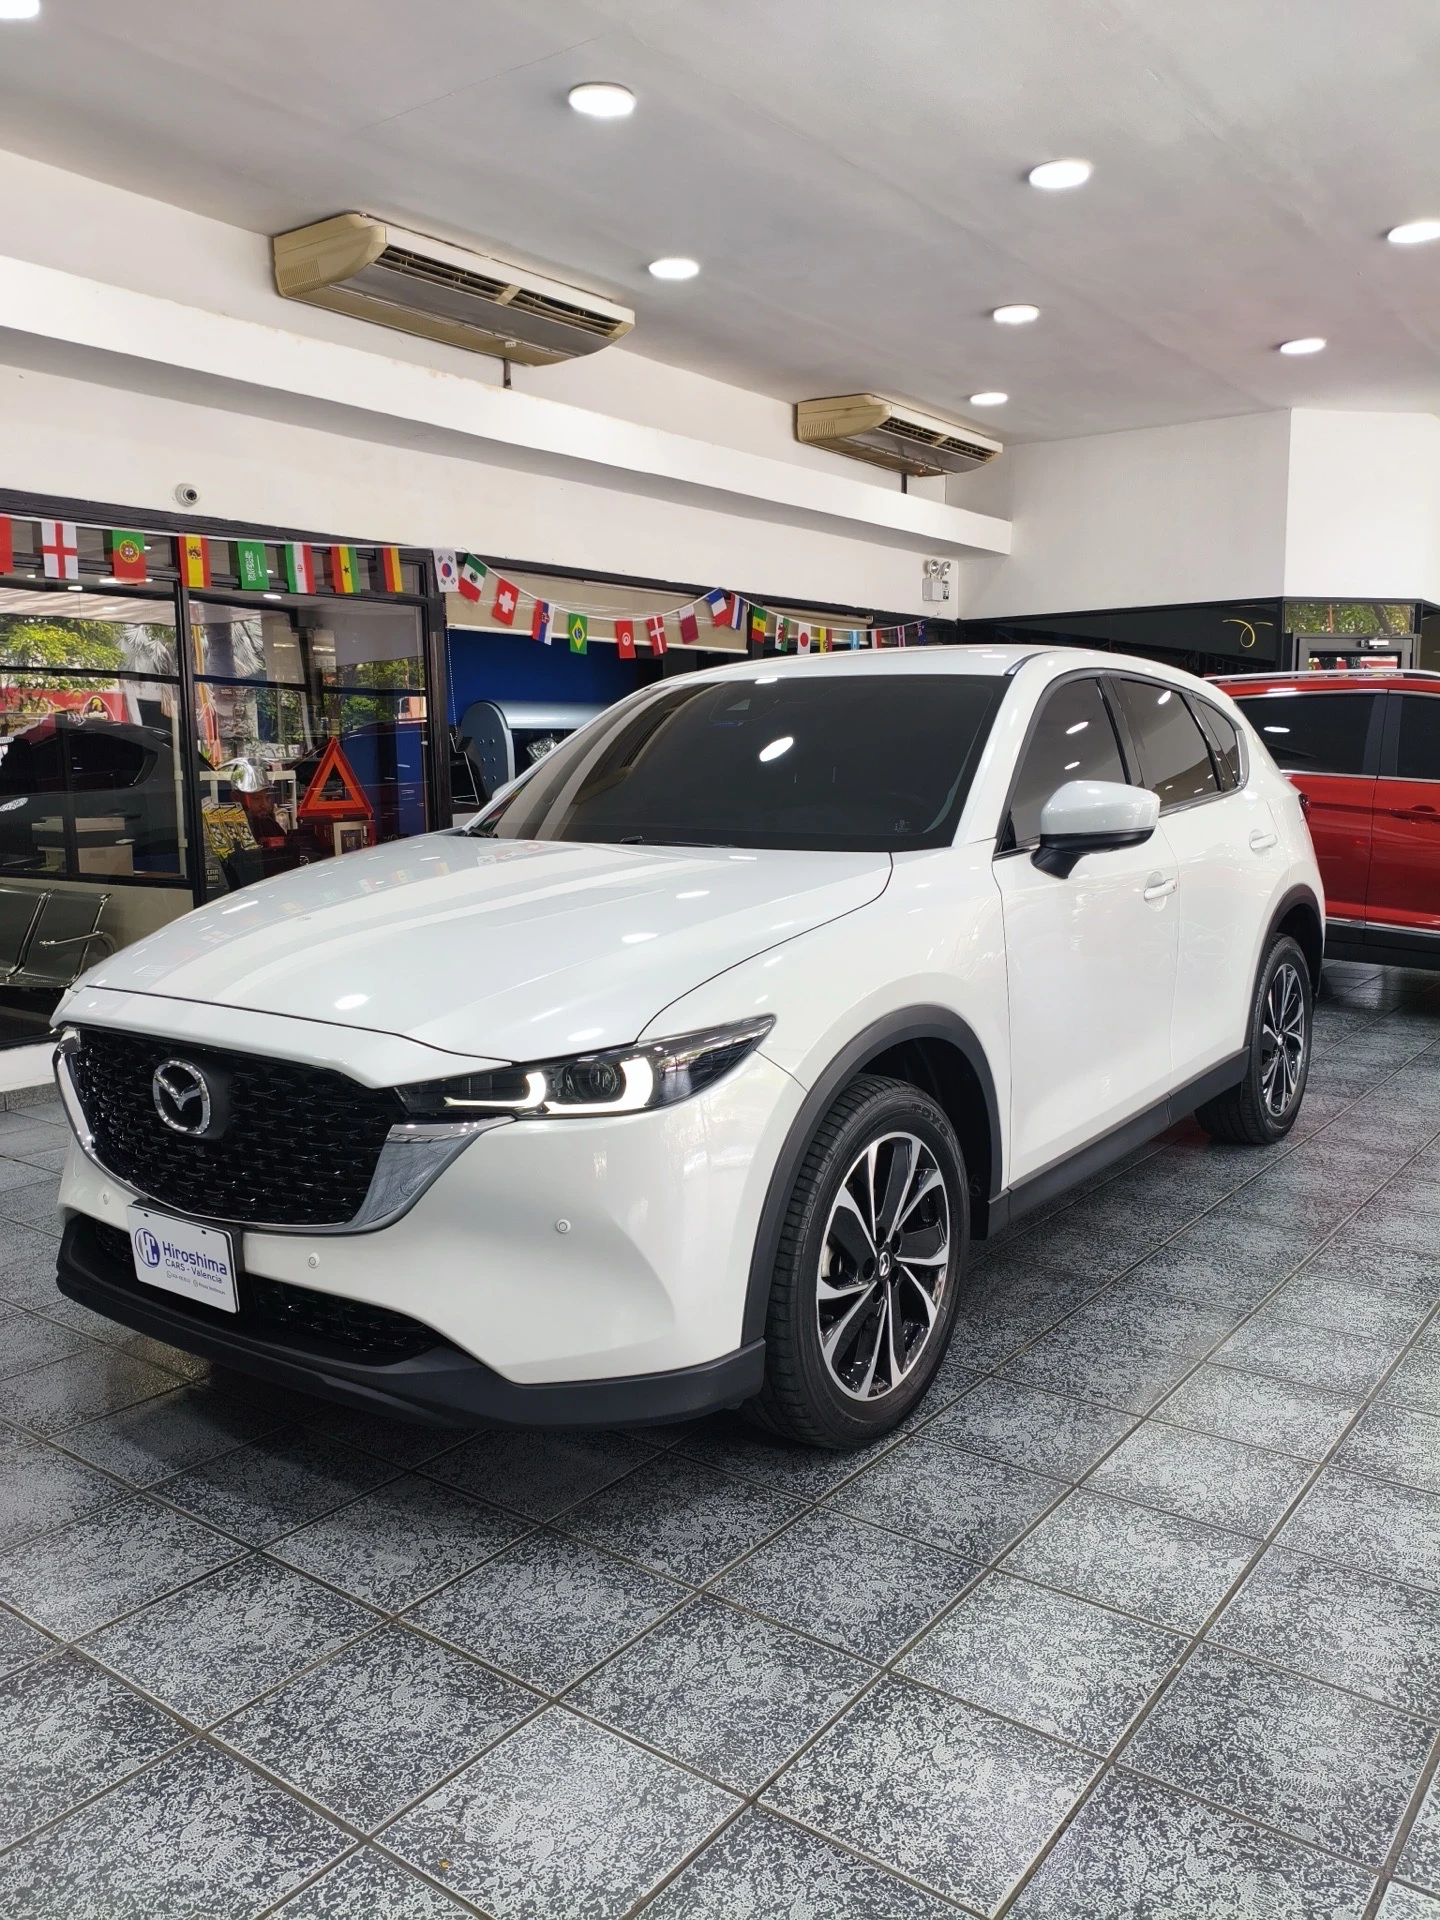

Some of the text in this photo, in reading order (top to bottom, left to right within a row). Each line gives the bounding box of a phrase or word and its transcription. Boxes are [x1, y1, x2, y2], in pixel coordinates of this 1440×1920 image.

[162, 1241, 227, 1276] Hiroshima
[165, 1258, 185, 1272] CARS
[191, 1266, 222, 1284] Valencia
